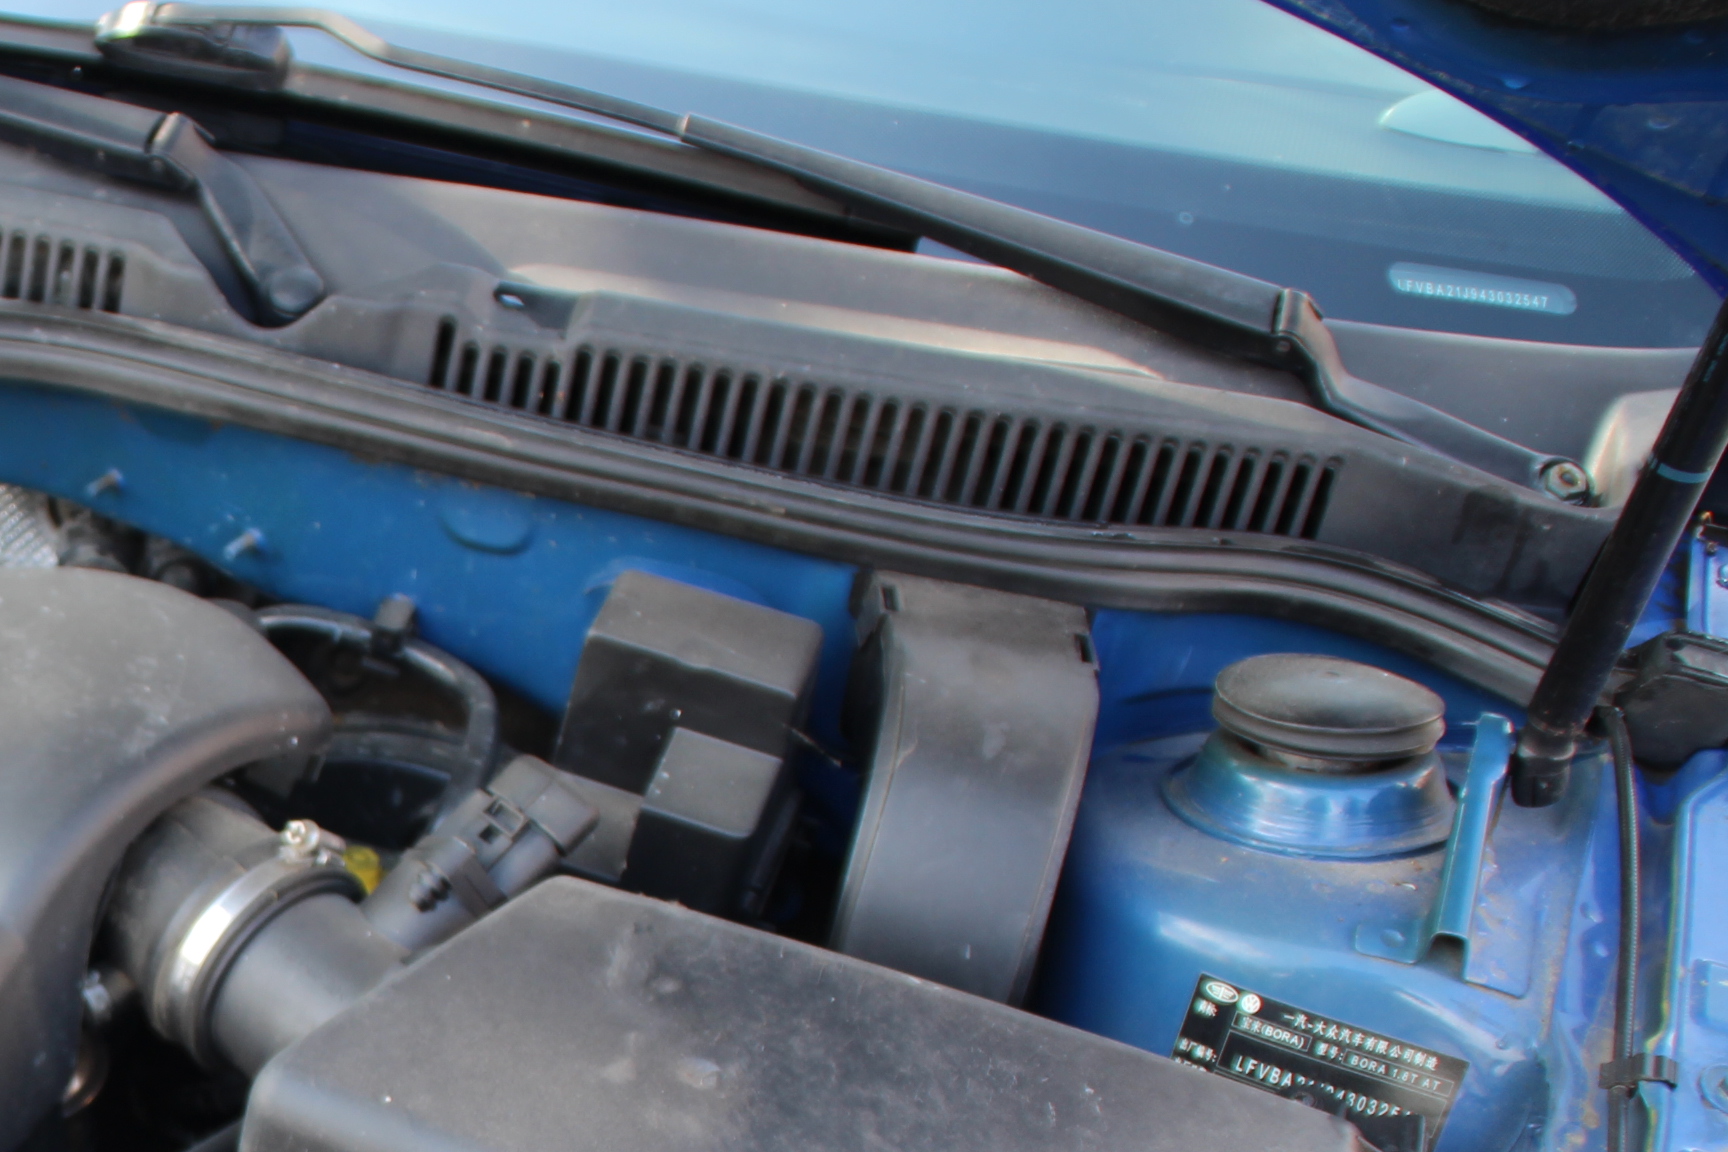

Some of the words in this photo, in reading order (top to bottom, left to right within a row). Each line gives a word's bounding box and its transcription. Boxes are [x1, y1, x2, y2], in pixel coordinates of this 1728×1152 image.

[1397, 279, 1548, 308] LFVBA21J943032547
[1350, 1054, 1387, 1075] BORA
[1421, 1078, 1442, 1091] AT
